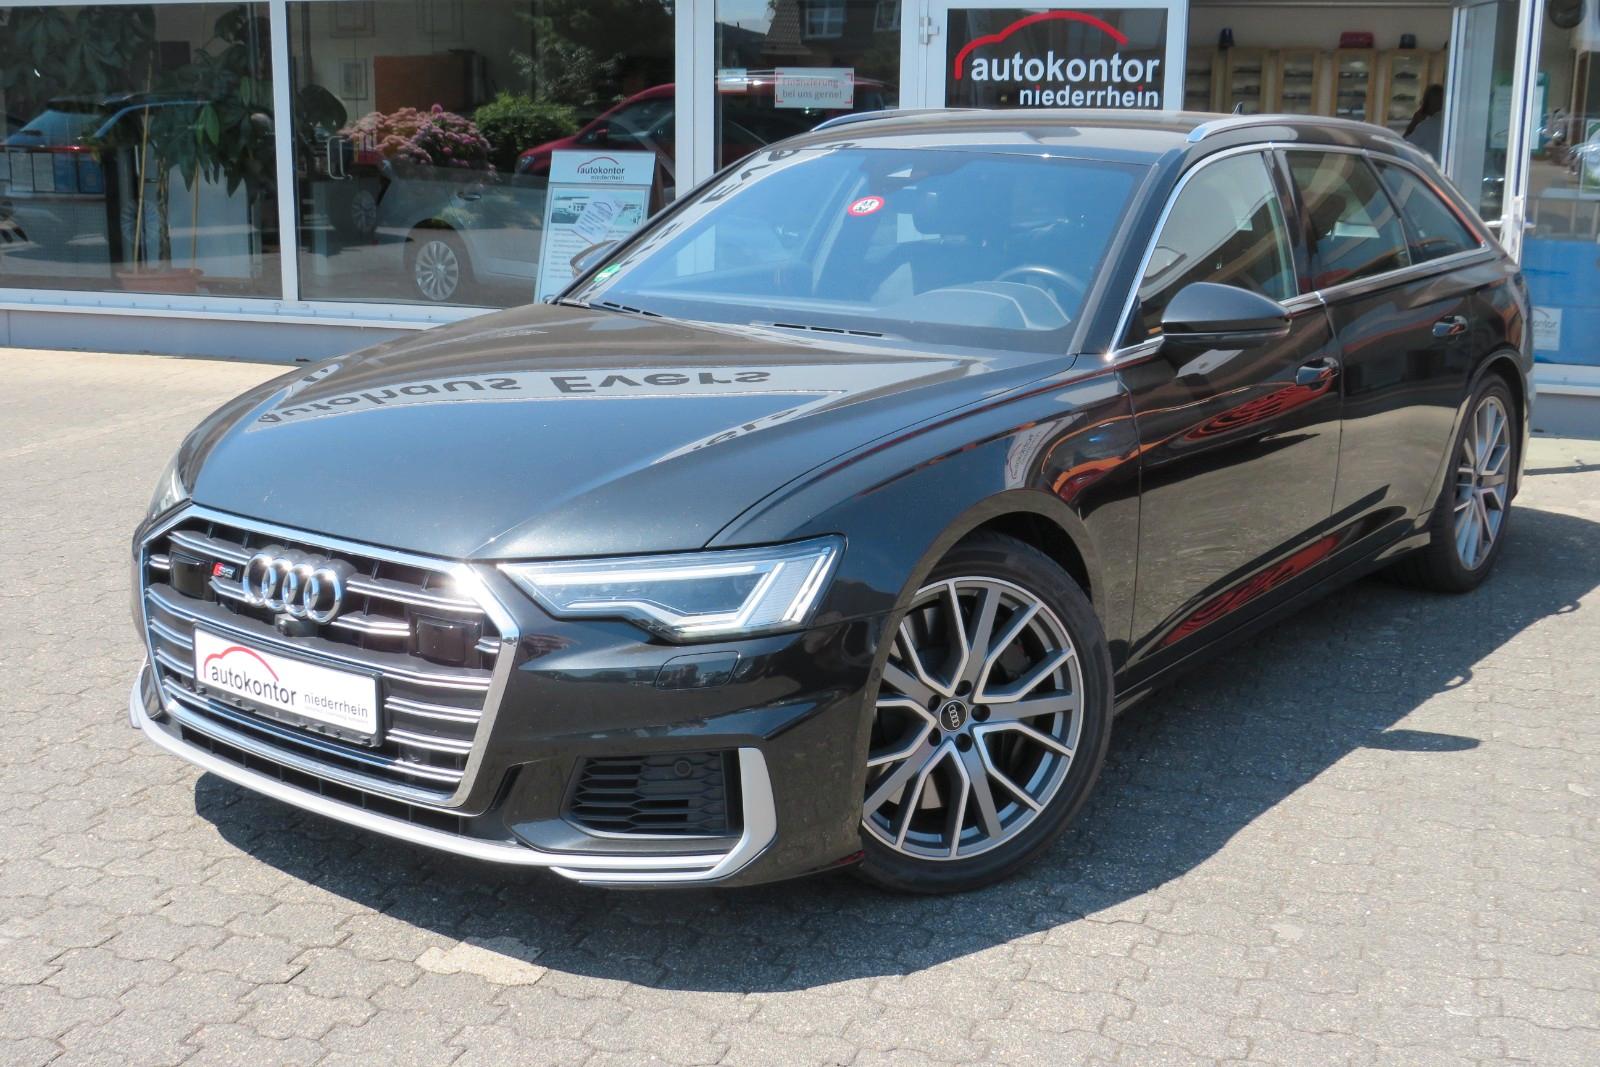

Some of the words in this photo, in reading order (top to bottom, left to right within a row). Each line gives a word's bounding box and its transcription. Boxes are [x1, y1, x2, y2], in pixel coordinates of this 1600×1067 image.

[970, 51, 1160, 83] autokontor
[782, 88, 795, 98] bei
[798, 90, 813, 98] uns
[1019, 85, 1159, 108] niederrhein
[580, 165, 625, 175] autokontor
[211, 664, 298, 706] autokontor
[304, 691, 368, 718] niederrhein
